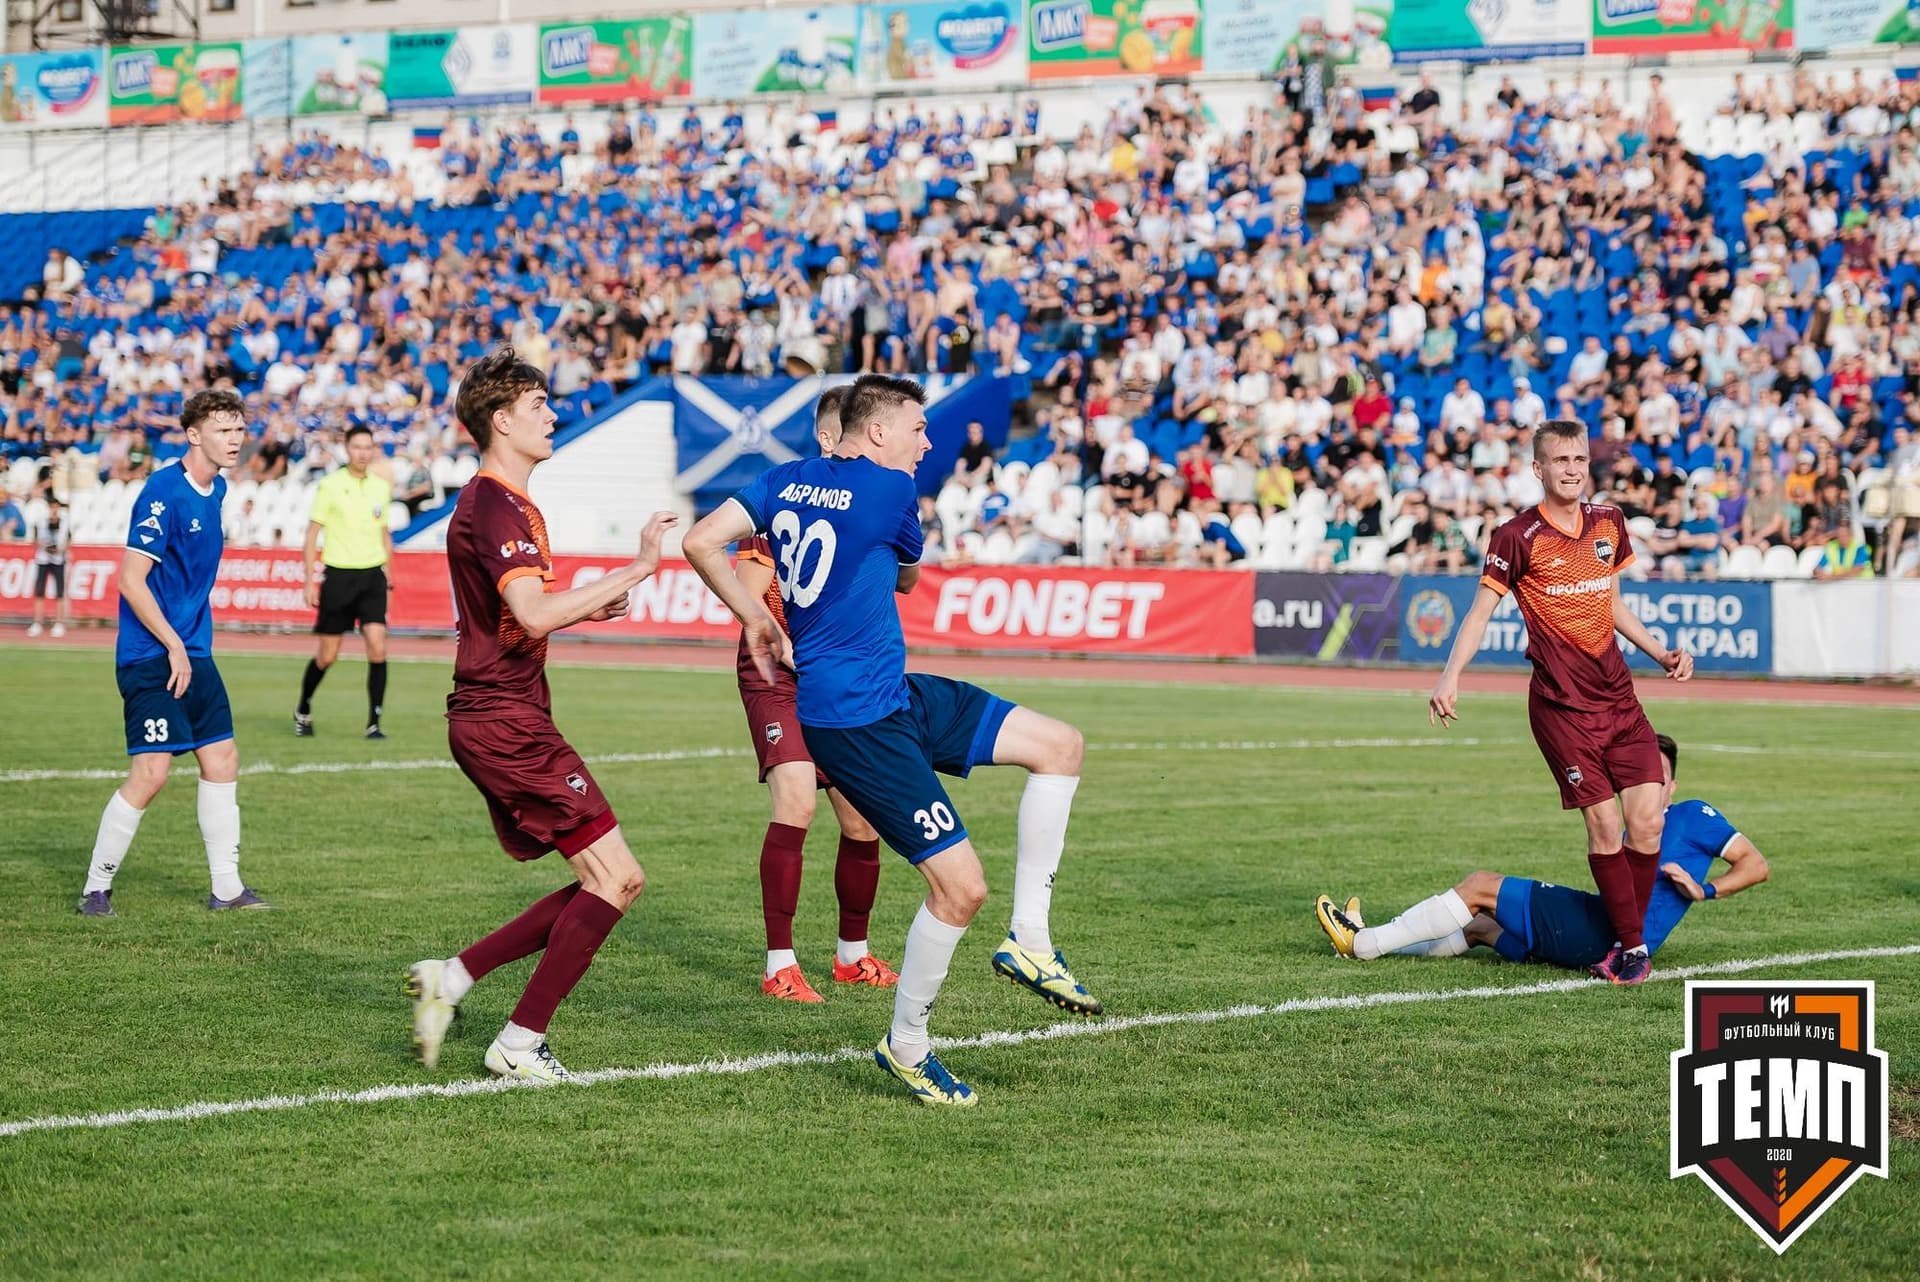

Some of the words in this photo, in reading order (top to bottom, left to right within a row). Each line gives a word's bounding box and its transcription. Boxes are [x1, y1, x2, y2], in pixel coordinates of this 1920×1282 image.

[778, 482, 853, 511] АБРАМОВ
[772, 510, 837, 608] 30
[933, 577, 1165, 639] FONBET
[1676, 626, 1758, 659] КРАЯ
[144, 718, 168, 742] 33
[914, 801, 955, 840] 30
